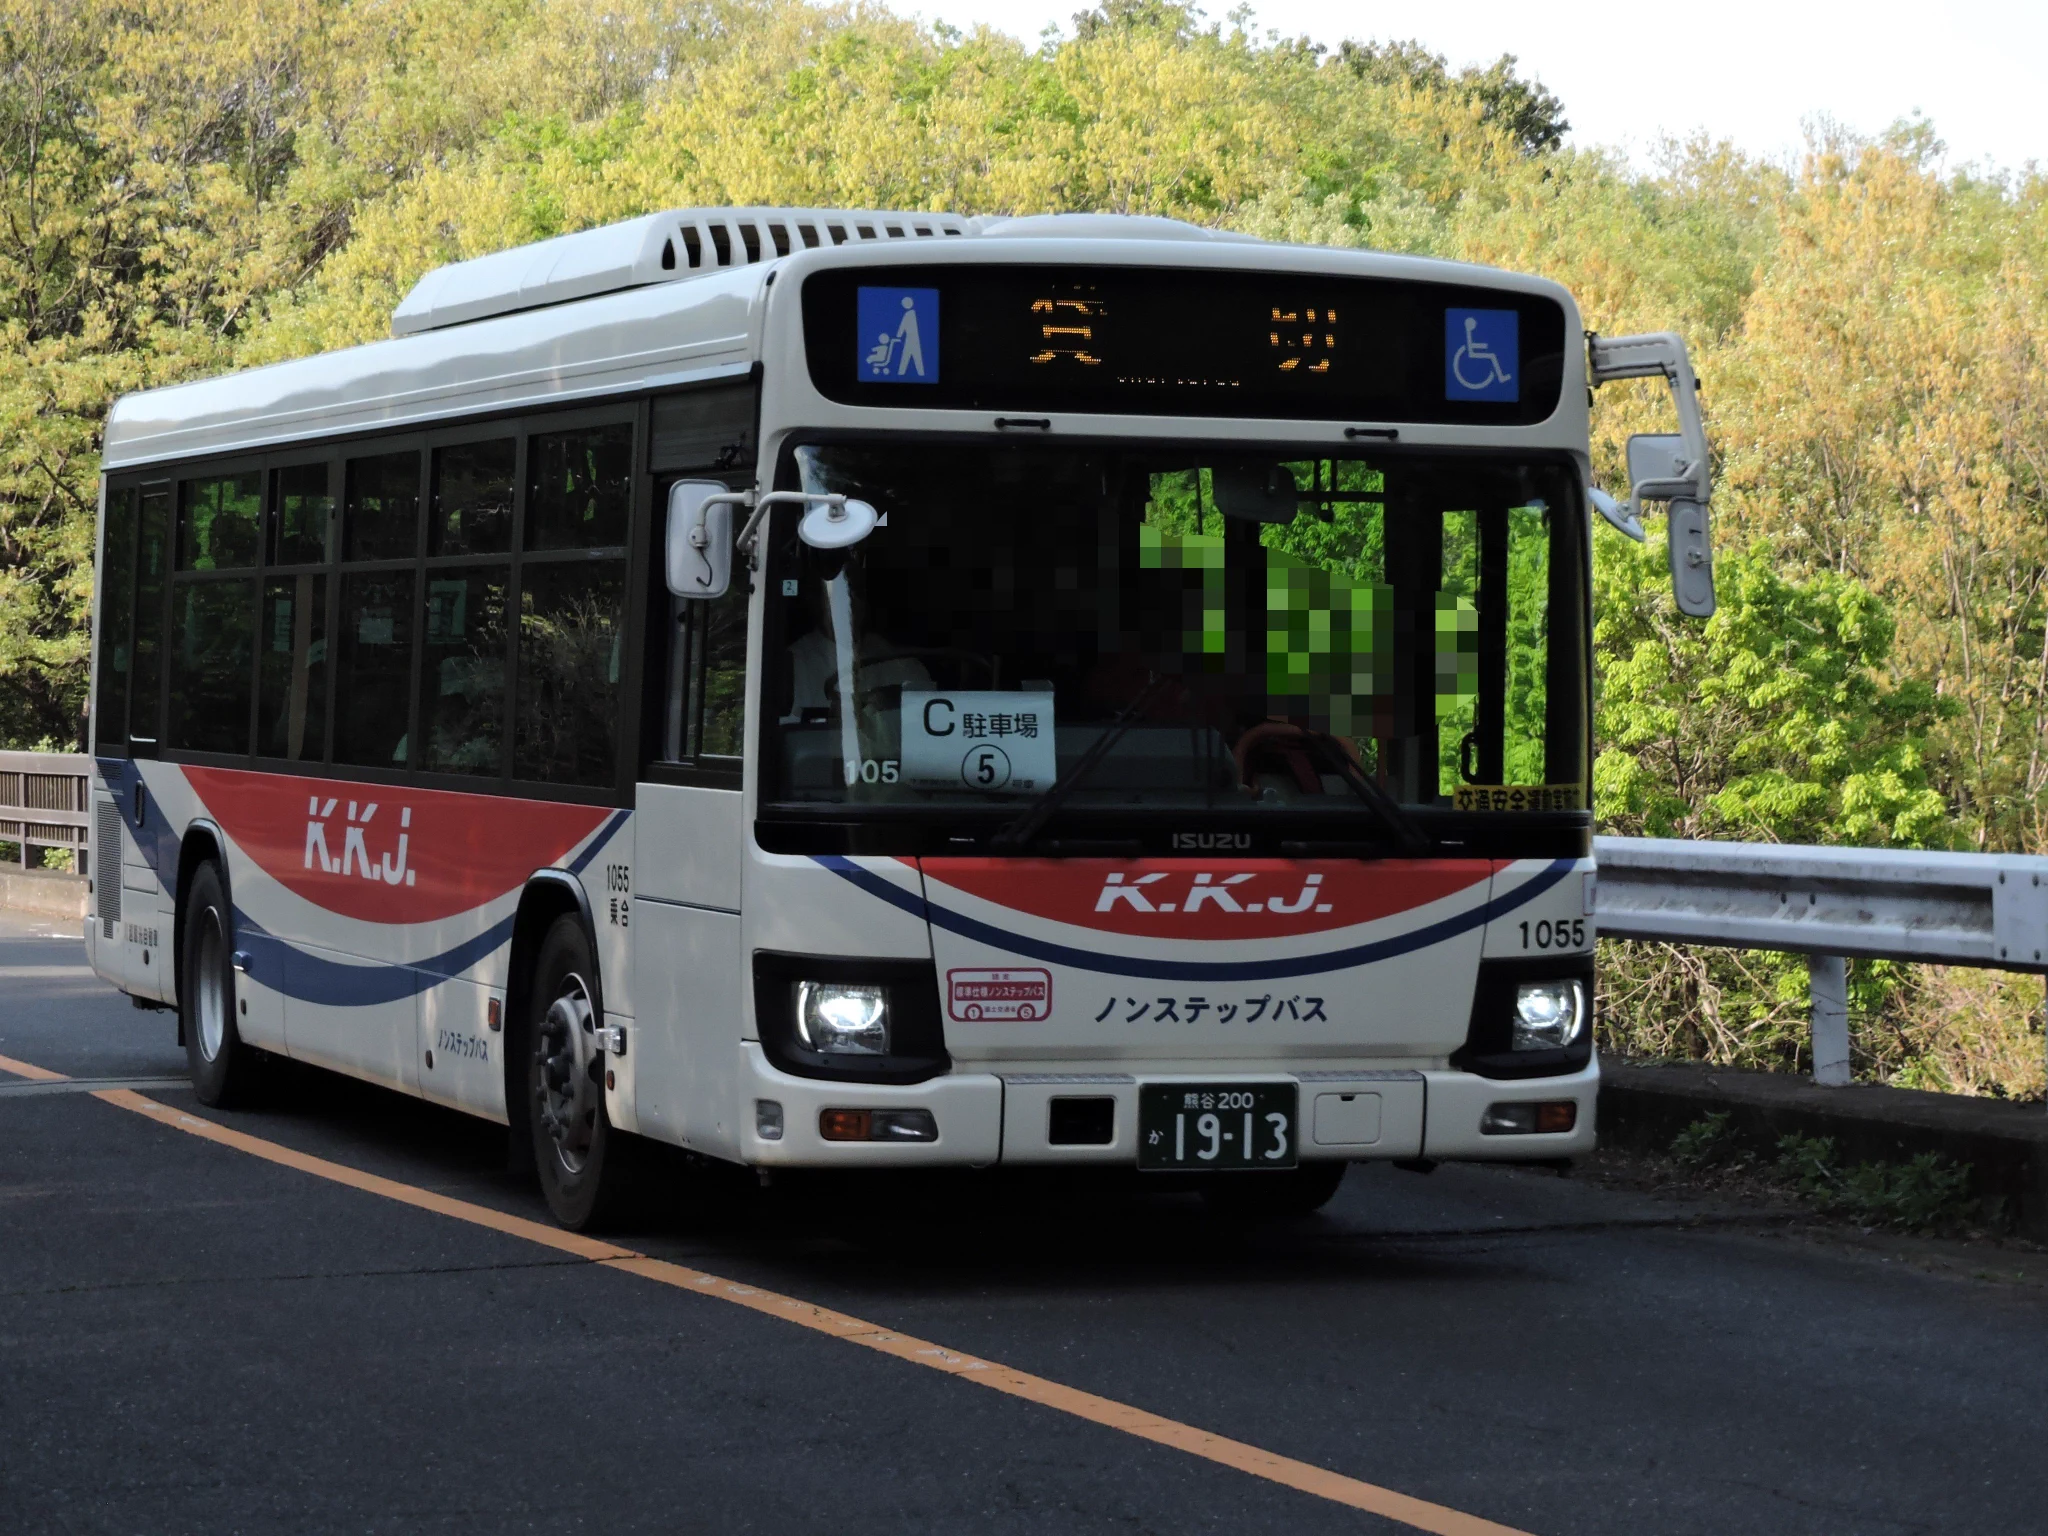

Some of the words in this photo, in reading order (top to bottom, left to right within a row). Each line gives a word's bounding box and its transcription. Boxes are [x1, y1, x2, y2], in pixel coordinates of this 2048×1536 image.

[304, 795, 416, 887] K.K.J.
[1172, 833, 1251, 849] ISUZU
[606, 864, 630, 893] 1055
[1094, 872, 1333, 913] K.K.J.
[1519, 919, 1585, 950] 1055
[1094, 994, 1328, 1024] ノンステップバス
[438, 1029, 489, 1062] ノンステップバス
[1148, 1130, 1164, 1145] か
[1175, 1112, 1288, 1161] 19-13
